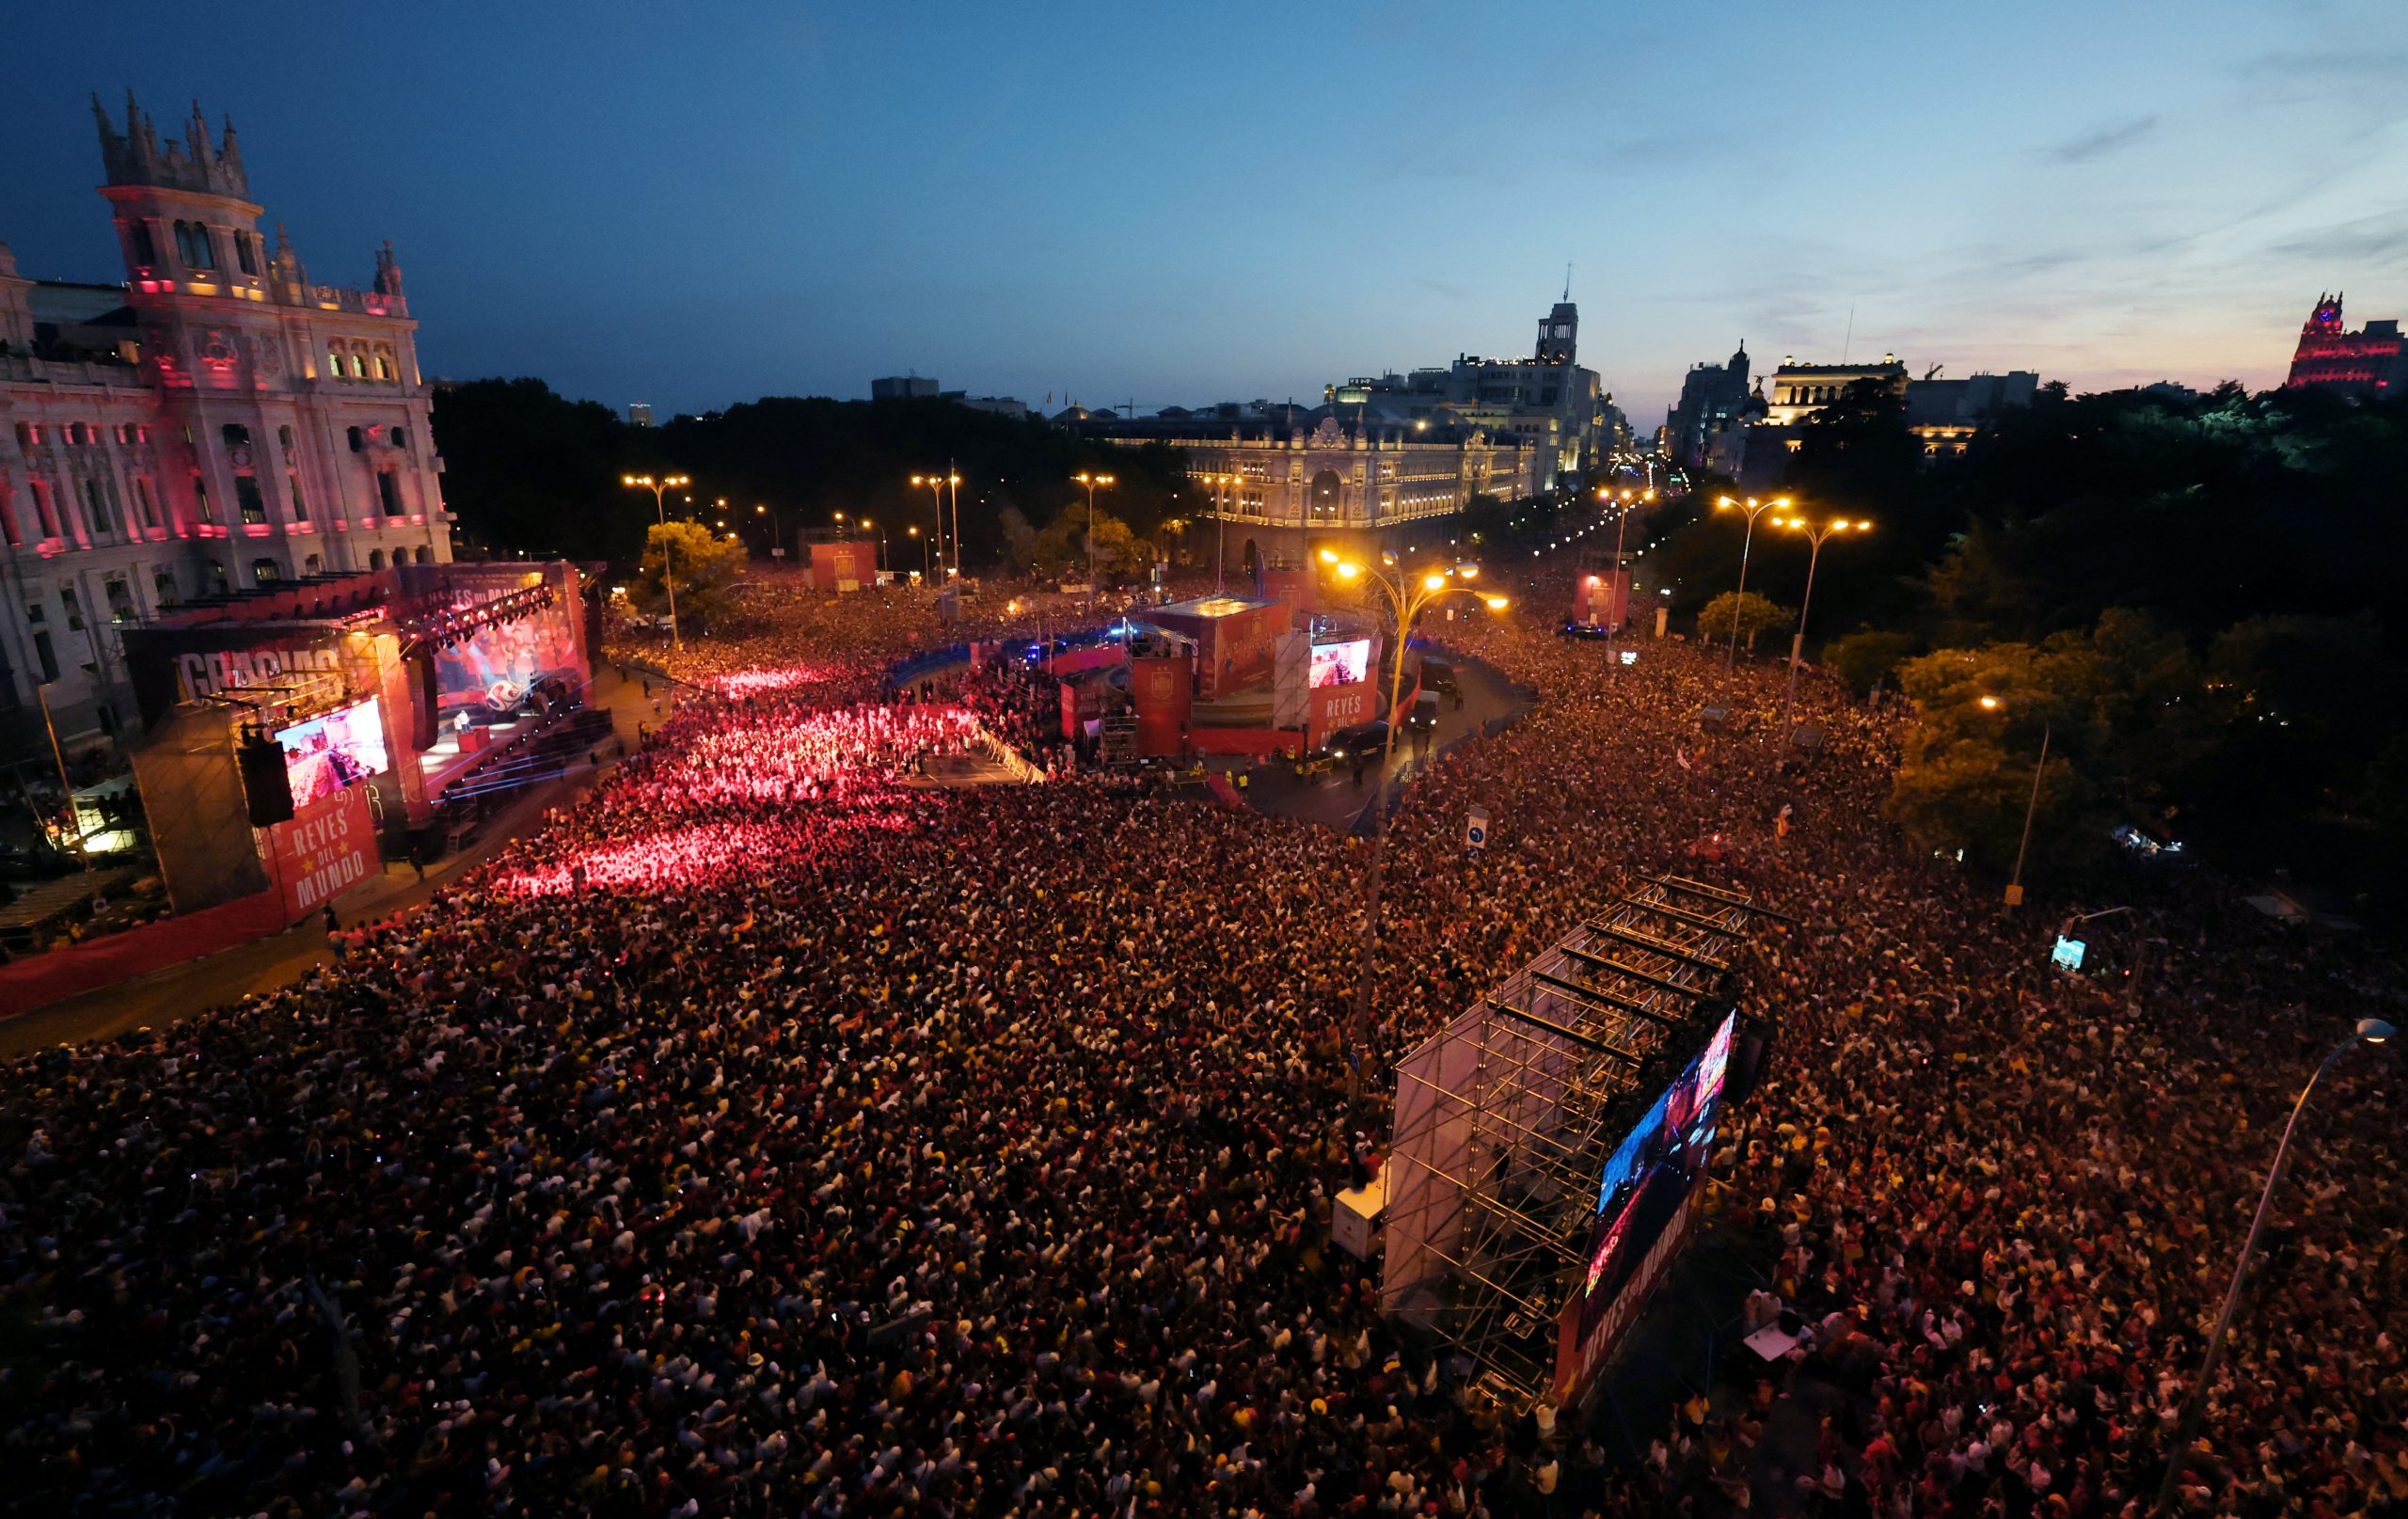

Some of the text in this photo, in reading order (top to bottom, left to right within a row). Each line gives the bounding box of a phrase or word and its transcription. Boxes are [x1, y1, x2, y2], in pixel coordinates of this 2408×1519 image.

[180, 649, 344, 702] GRACIAS
[1327, 695, 1361, 718] REYES
[1338, 717, 1349, 728] DEL
[292, 809, 348, 857] REYES
[317, 847, 335, 865] DEL
[296, 850, 364, 910] MUNDO
